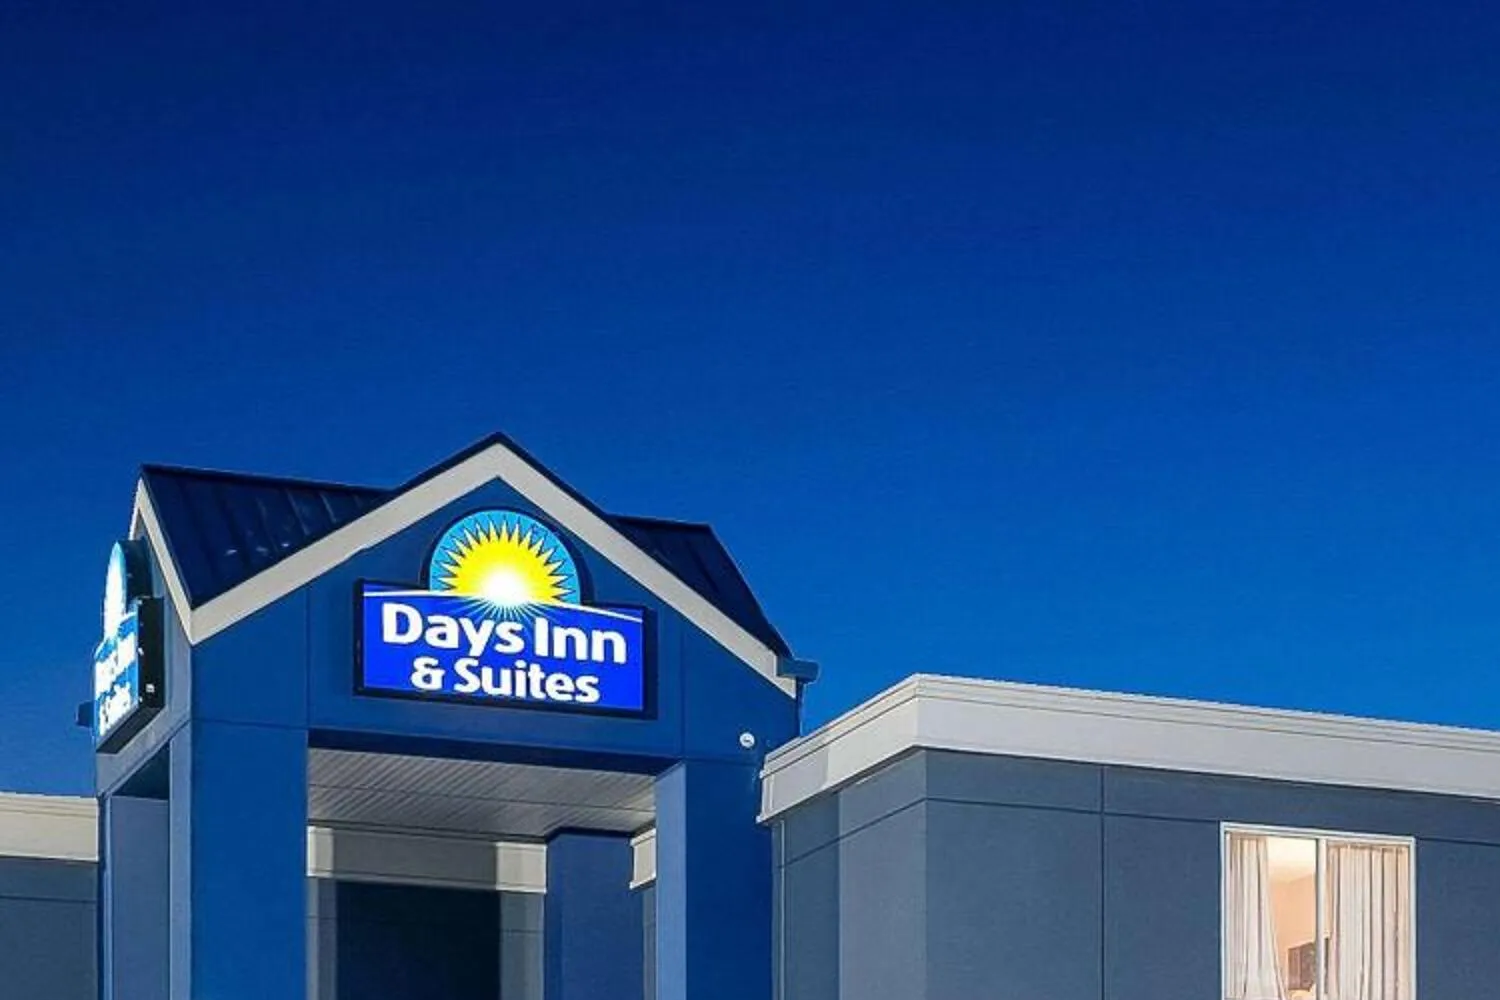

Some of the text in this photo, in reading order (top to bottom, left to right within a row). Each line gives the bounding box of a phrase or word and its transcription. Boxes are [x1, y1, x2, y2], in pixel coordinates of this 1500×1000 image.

[381, 602, 627, 664] Days Inn
[410, 656, 600, 703] & Suites
